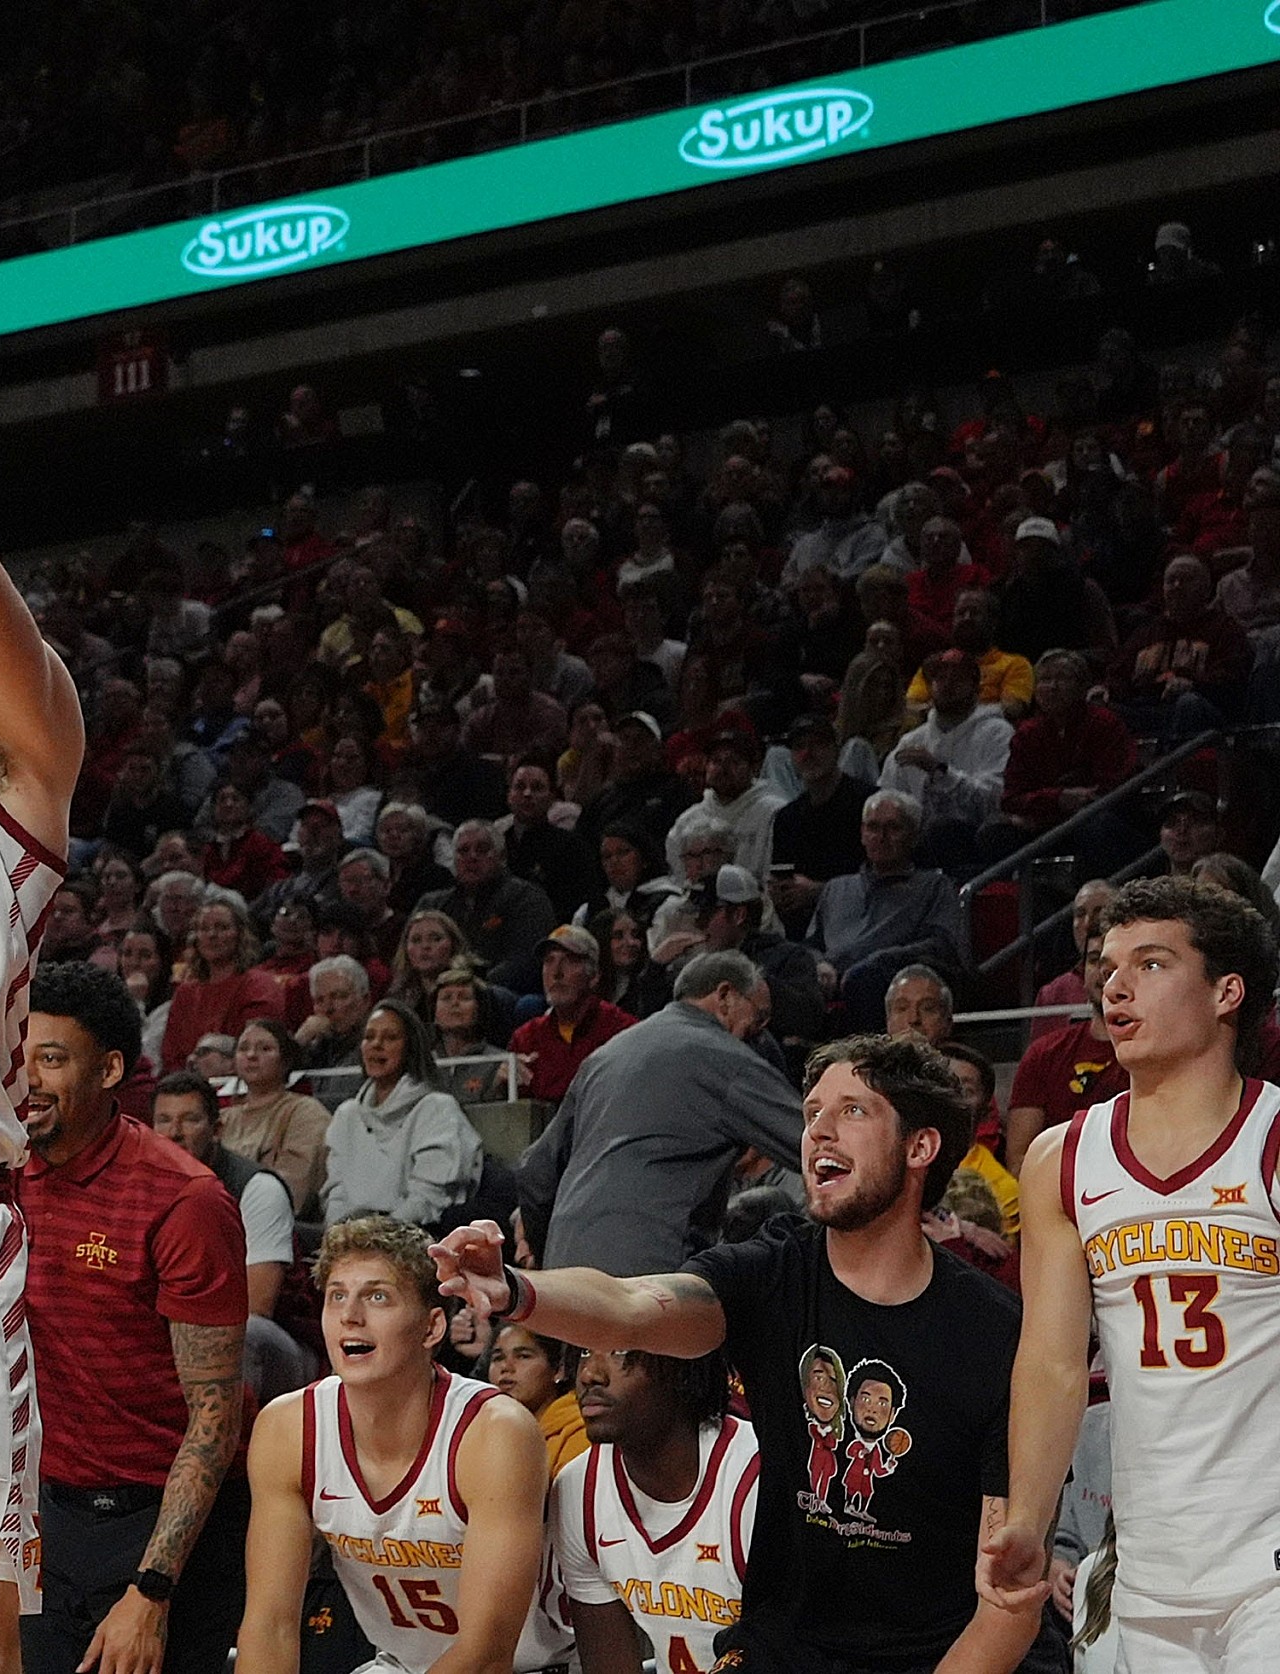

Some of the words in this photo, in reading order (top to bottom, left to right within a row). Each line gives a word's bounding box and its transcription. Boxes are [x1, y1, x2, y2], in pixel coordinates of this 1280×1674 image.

[697, 99, 854, 158] Sukup
[197, 215, 332, 267] Sukup
[75, 1243, 118, 1265] STATE
[1085, 1220, 1280, 1278] CYCLONES
[1132, 1273, 1230, 1369] 13
[322, 1532, 465, 1569] YCLONE
[371, 1574, 460, 1636] 15
